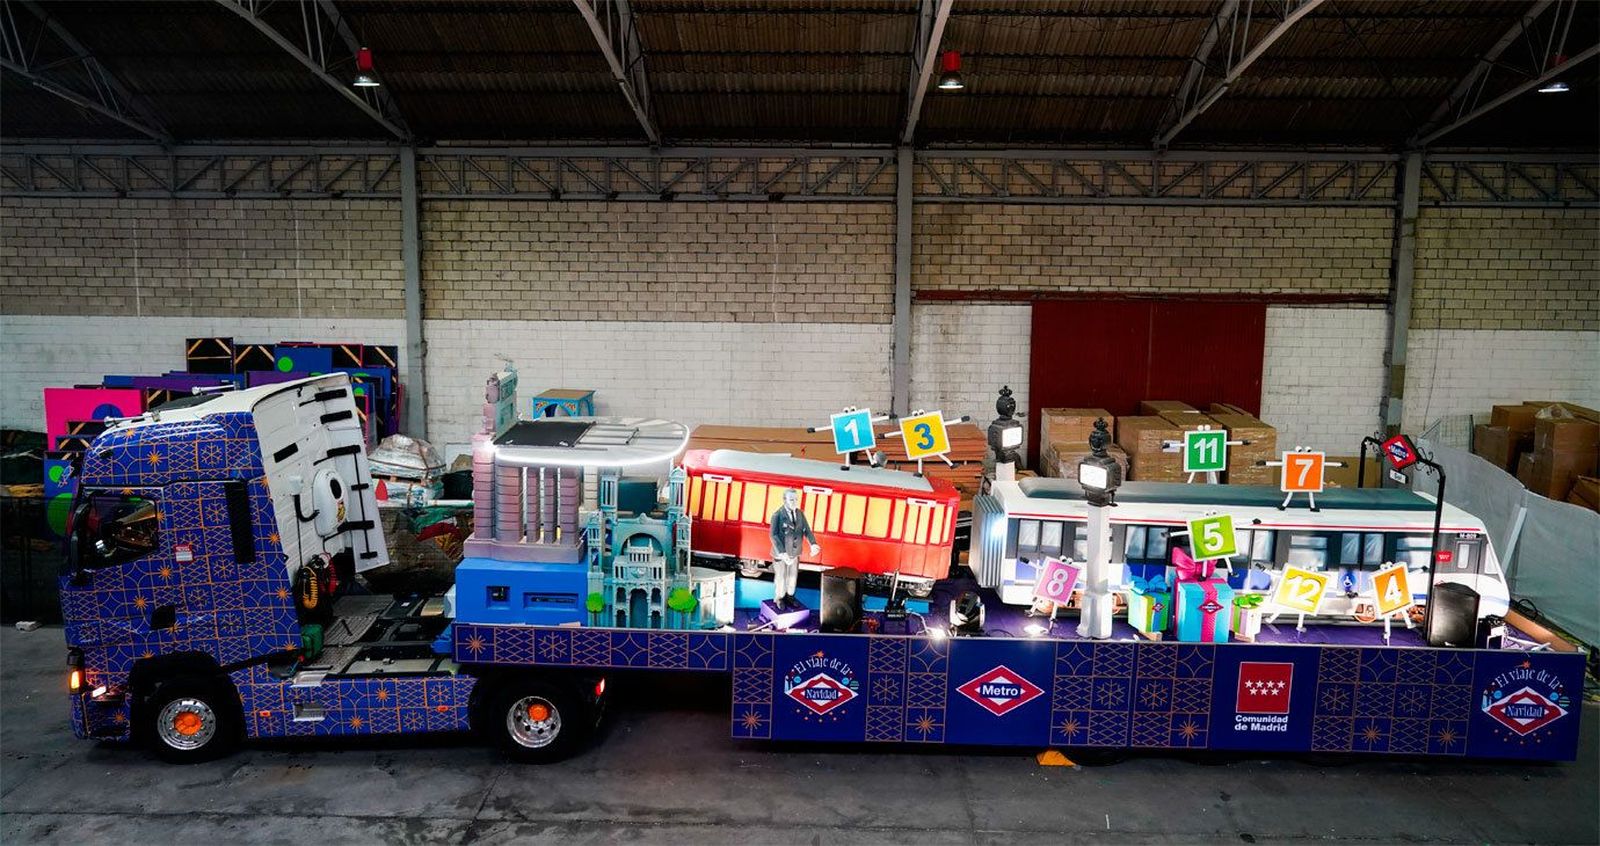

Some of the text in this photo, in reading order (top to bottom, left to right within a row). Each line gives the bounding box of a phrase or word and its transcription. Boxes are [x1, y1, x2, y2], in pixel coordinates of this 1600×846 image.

[844, 419, 860, 446] 1
[914, 423, 934, 450] 3
[1194, 438, 1218, 463] 11
[1295, 459, 1313, 486] 7
[1203, 523, 1224, 551] 5
[1047, 569, 1068, 596] 8
[1286, 575, 1321, 606] 12
[1384, 575, 1402, 605] 4
[794, 661, 806, 674] El
[829, 658, 841, 670] de
[840, 663, 851, 675] la
[982, 684, 1018, 696] Metro
[1495, 673, 1509, 688] El
[1536, 669, 1550, 683] de
[1548, 676, 1560, 690] la
[806, 689, 837, 699] Navidad
[1235, 714, 1289, 723] Comunidad
[1507, 705, 1543, 717] Navidad
[1234, 722, 1288, 732] de Madrid
